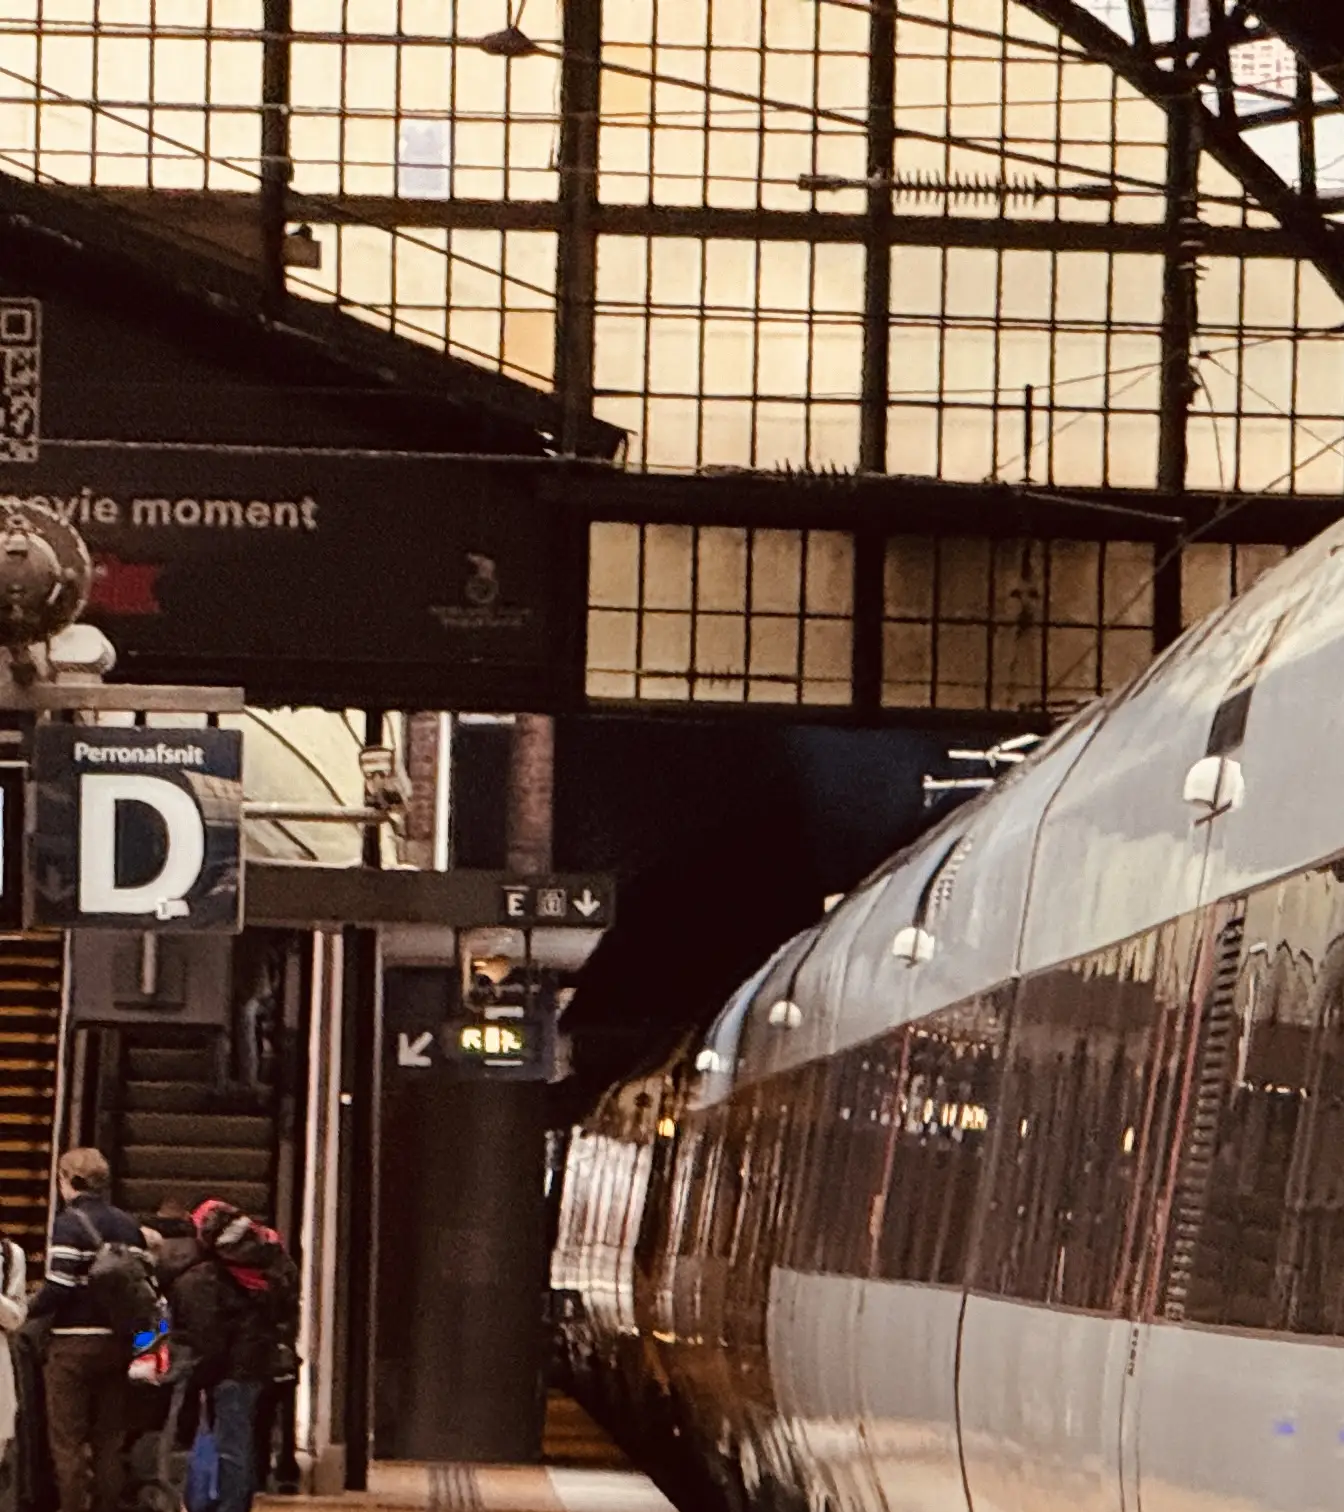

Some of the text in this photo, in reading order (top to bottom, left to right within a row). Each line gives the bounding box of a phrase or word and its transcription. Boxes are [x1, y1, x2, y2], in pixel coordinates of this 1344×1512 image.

[132, 496, 318, 530] moment
[74, 741, 205, 765] Perronafsnit
[79, 773, 205, 914] D
[506, 892, 526, 917] E
